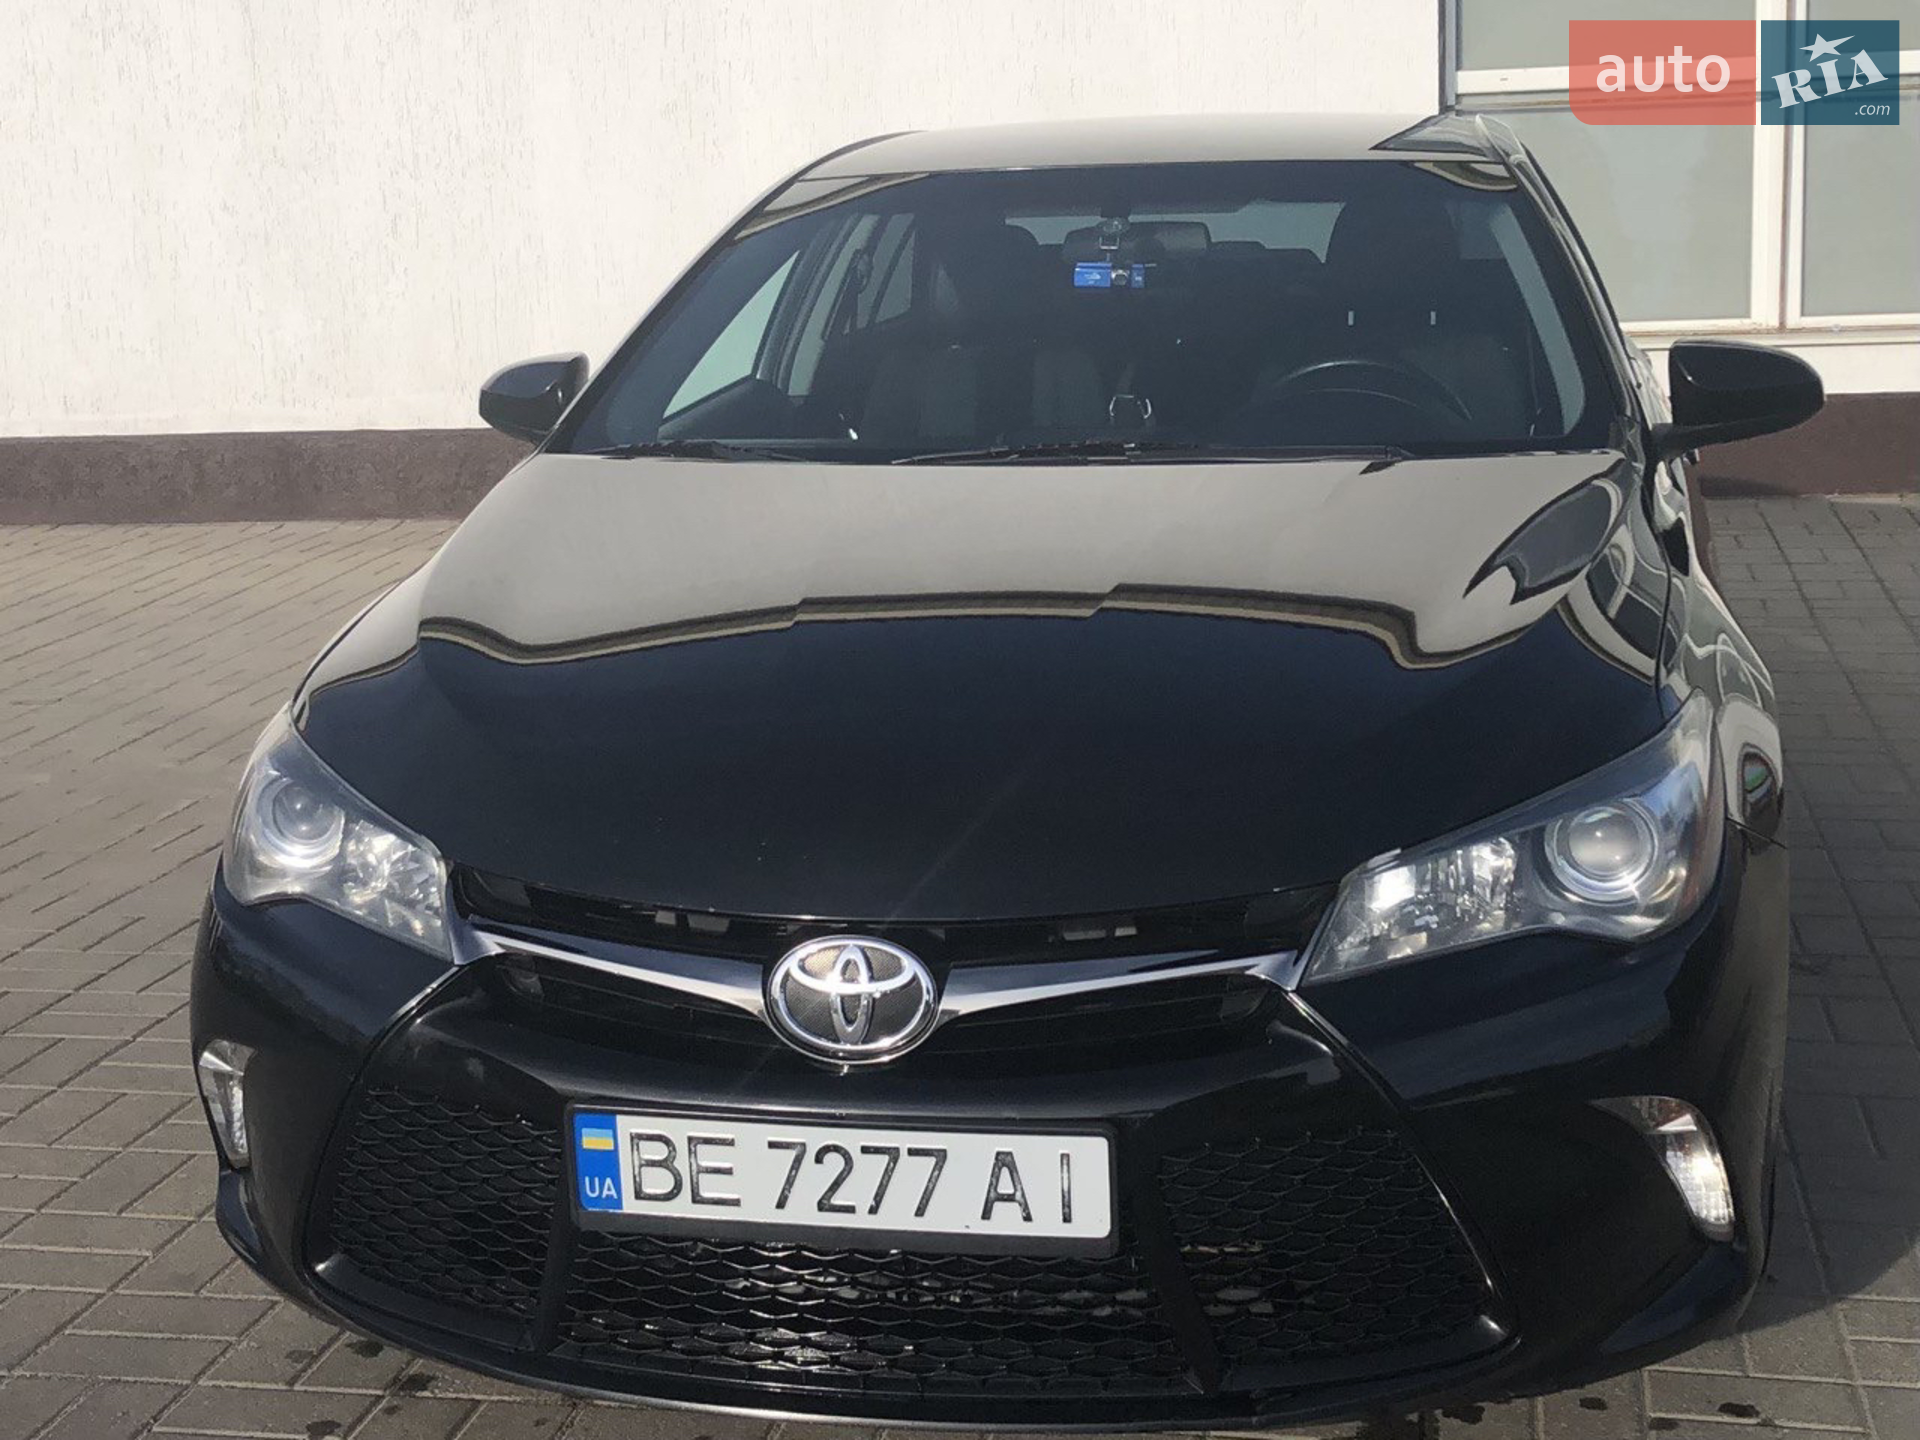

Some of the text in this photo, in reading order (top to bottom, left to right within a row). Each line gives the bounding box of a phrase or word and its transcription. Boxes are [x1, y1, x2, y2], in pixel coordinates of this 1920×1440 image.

[584, 1175, 618, 1200] UA
[629, 1129, 1073, 1224] BE 7277 AI
